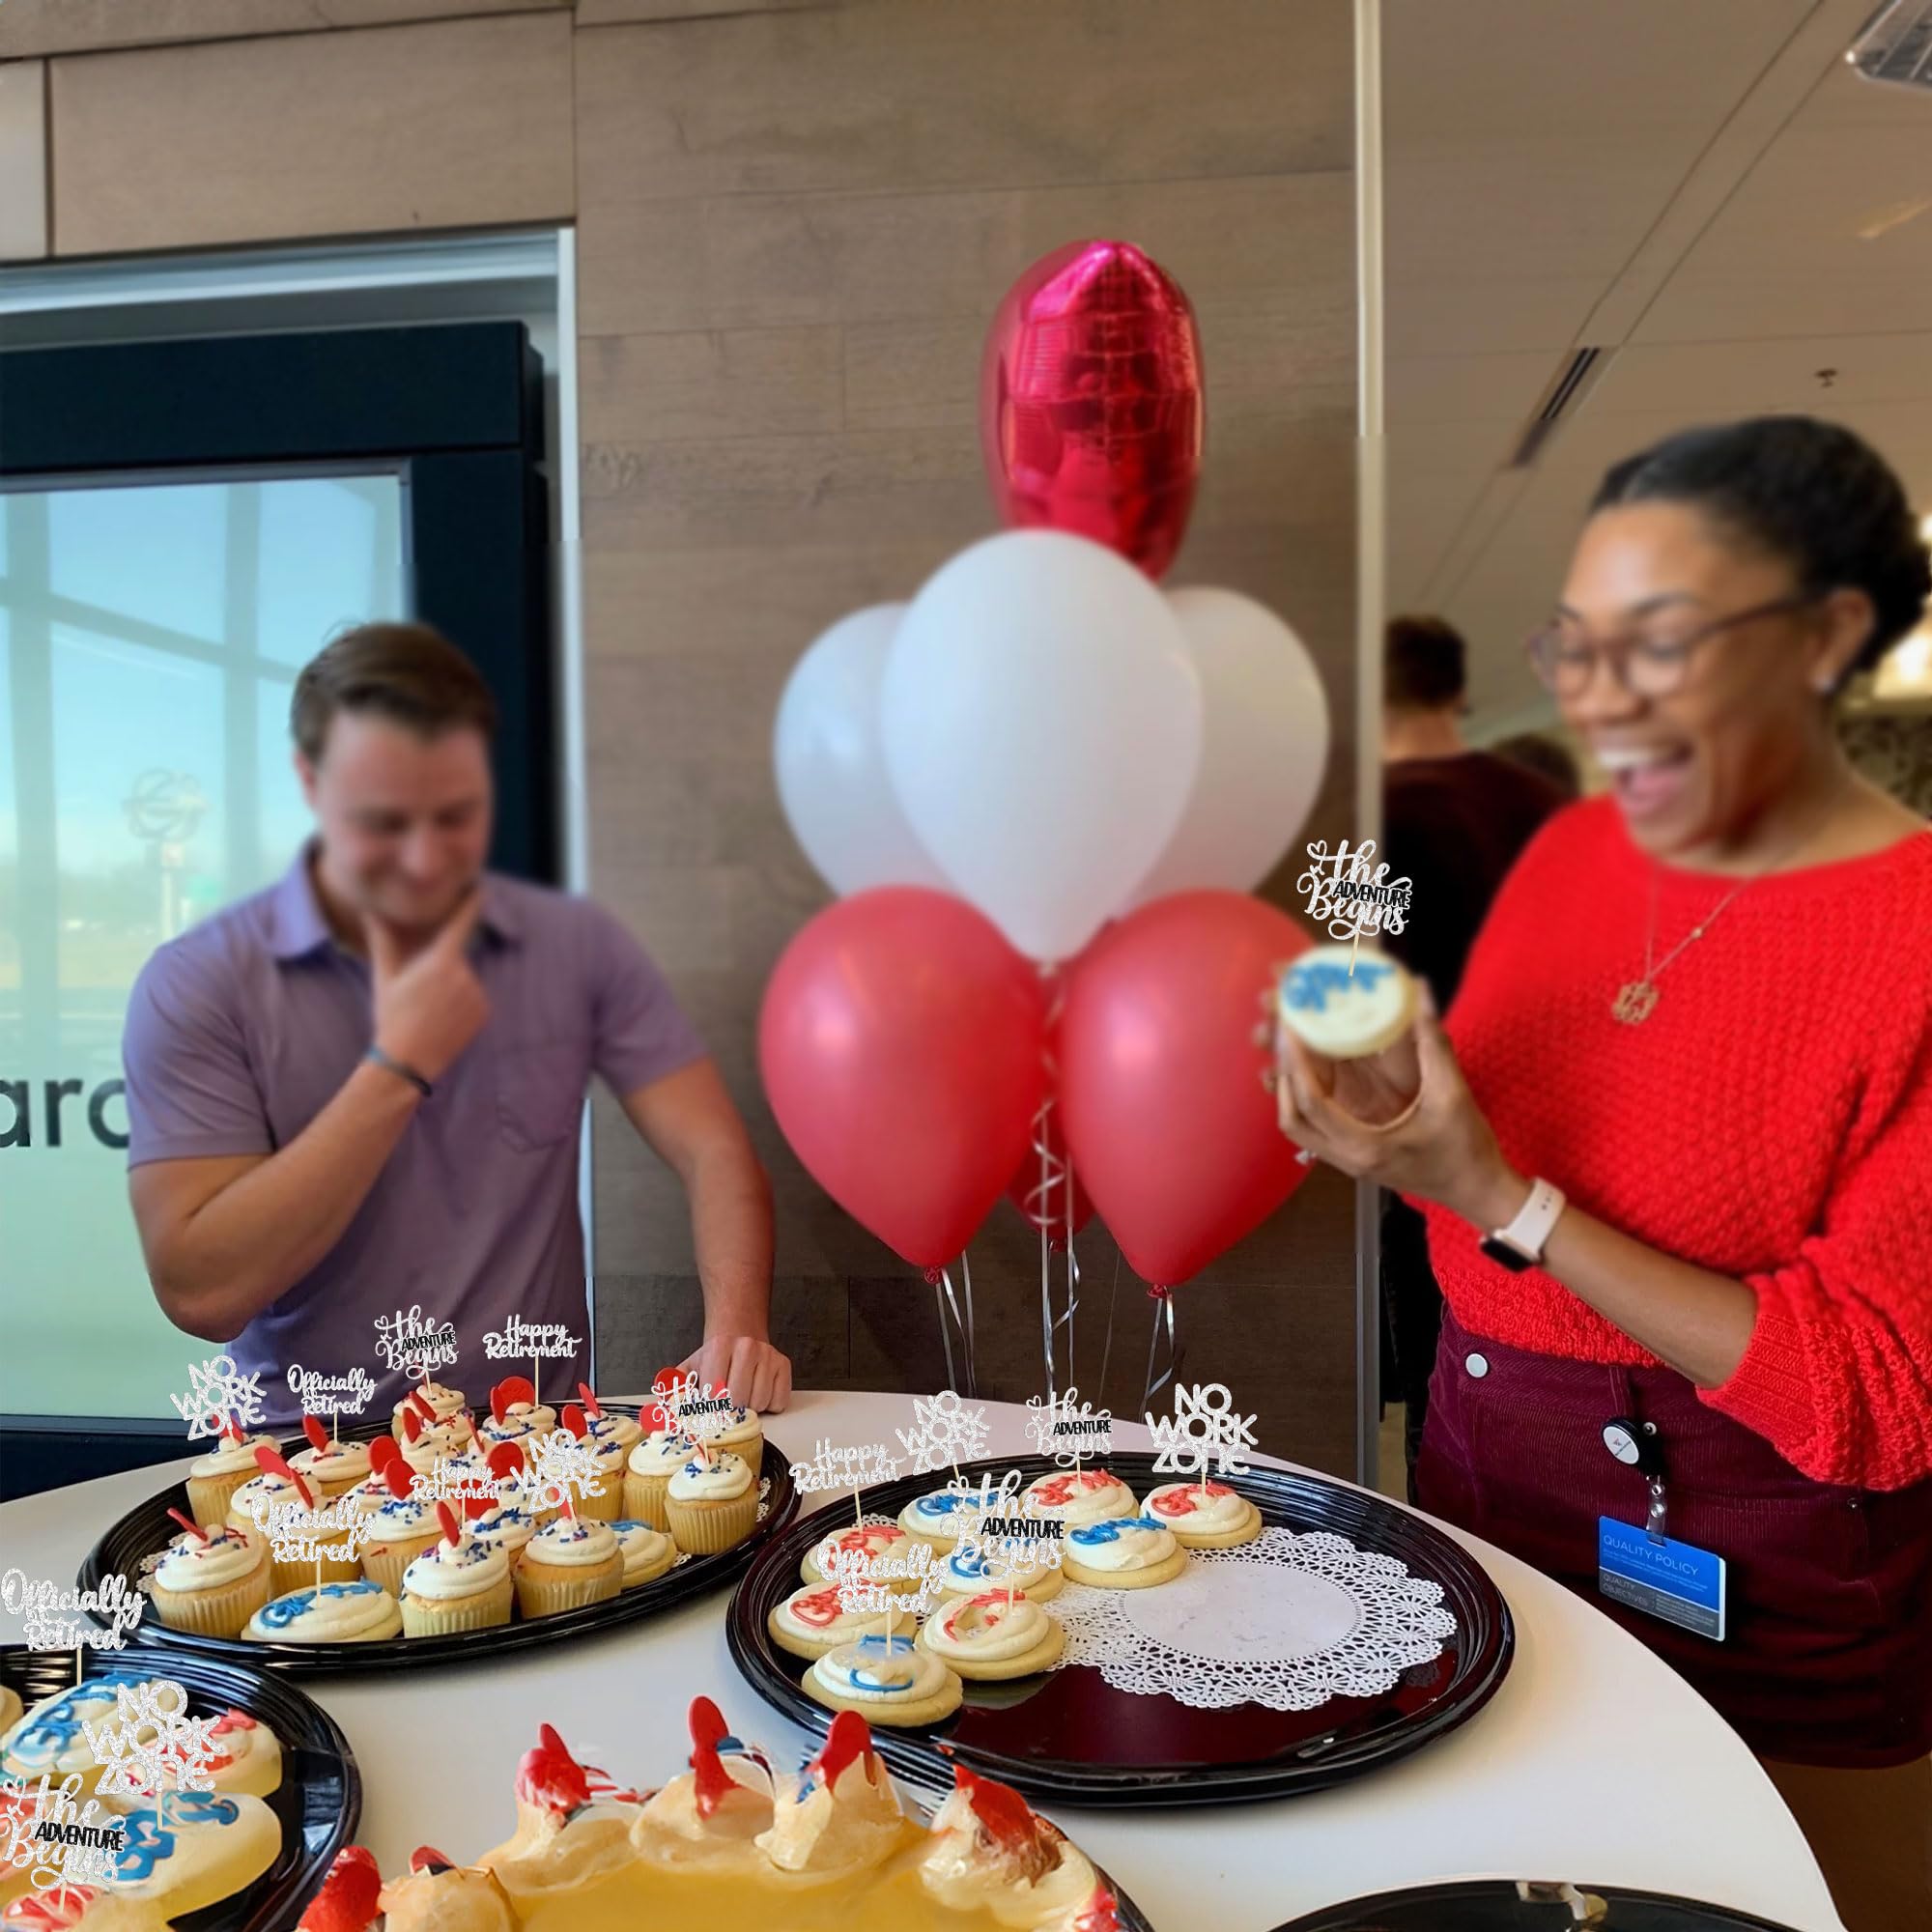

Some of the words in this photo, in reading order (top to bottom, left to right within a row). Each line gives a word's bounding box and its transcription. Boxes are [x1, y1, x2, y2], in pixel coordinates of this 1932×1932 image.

[1307, 839, 1392, 888] the
[1297, 872, 1409, 940] Begins
[1333, 880, 1412, 910] ADVENTURE
[374, 1305, 436, 1340] the
[504, 1314, 568, 1343] Happy
[401, 1331, 456, 1351] ADVENTURE
[483, 1332, 582, 1359] Retirement
[188, 1355, 237, 1389] NO
[375, 1339, 459, 1379] Begins
[170, 1372, 267, 1418] WORK
[287, 1363, 378, 1402] Officially
[651, 1371, 713, 1406] the
[1175, 1383, 1233, 1415] NO
[301, 1393, 366, 1415] Retired
[678, 1397, 733, 1418] ADVENTURE
[912, 1390, 962, 1424] NO
[1026, 1387, 1093, 1423] the
[895, 1406, 991, 1455] WORK
[1053, 1419, 1113, 1436] ADVENTURE
[1145, 1411, 1259, 1447] WORK
[527, 1428, 577, 1462] NO
[812, 1437, 890, 1469] Happy
[431, 1458, 495, 1483] Happy
[510, 1445, 608, 1492] WORK
[788, 1457, 907, 1495] Retirement
[410, 1473, 504, 1500] Retirement
[947, 1469, 1039, 1520] the
[251, 1492, 376, 1545] Officially
[980, 1517, 1065, 1540] ADVENTURE
[270, 1533, 360, 1563] Retired
[1604, 1534, 1653, 1559] QUALITY
[1655, 1553, 1699, 1576] POLICY
[816, 1538, 951, 1594] Officially
[1604, 1573, 1635, 1590] QUALITY
[1, 1568, 147, 1630] Officially
[838, 1584, 932, 1614] Retired
[23, 1618, 128, 1652] Retired
[117, 1680, 188, 1721] NO
[81, 1716, 224, 1764] WORK
[2, 1773, 100, 1826] the
[34, 1821, 126, 1852] ADVENTURE
